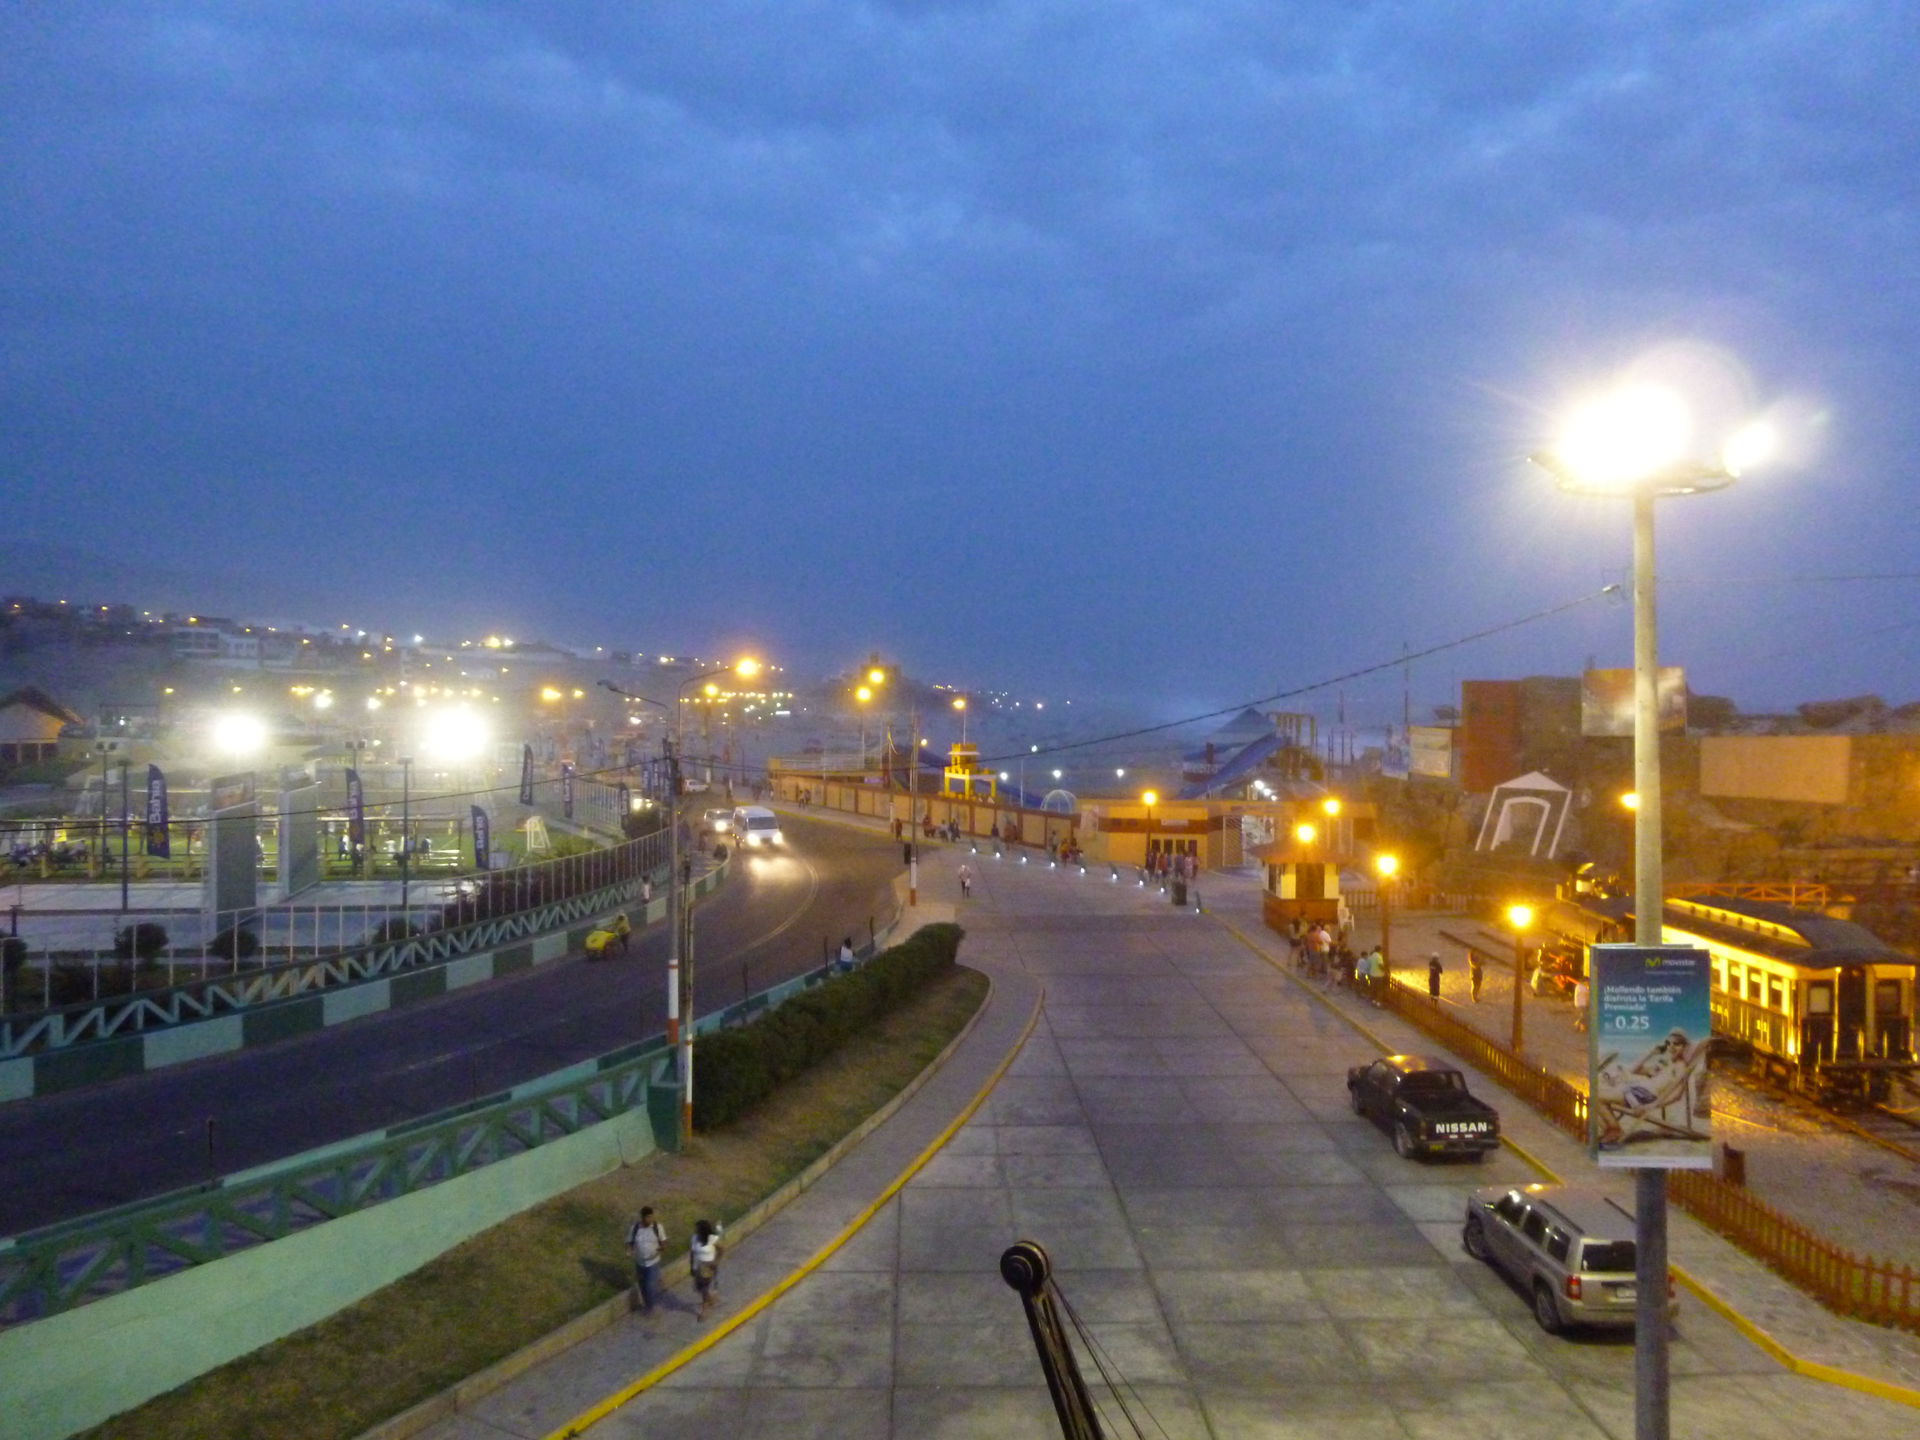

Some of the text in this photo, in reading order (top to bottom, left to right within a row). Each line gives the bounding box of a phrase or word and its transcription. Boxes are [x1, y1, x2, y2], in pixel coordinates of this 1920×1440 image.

[1662, 959, 1696, 967] movistar
[1604, 995, 1674, 1003] disfruta la Tarifa
[1615, 1016, 1650, 1030] 0.25
[1435, 1122, 1487, 1134] NISSAN
